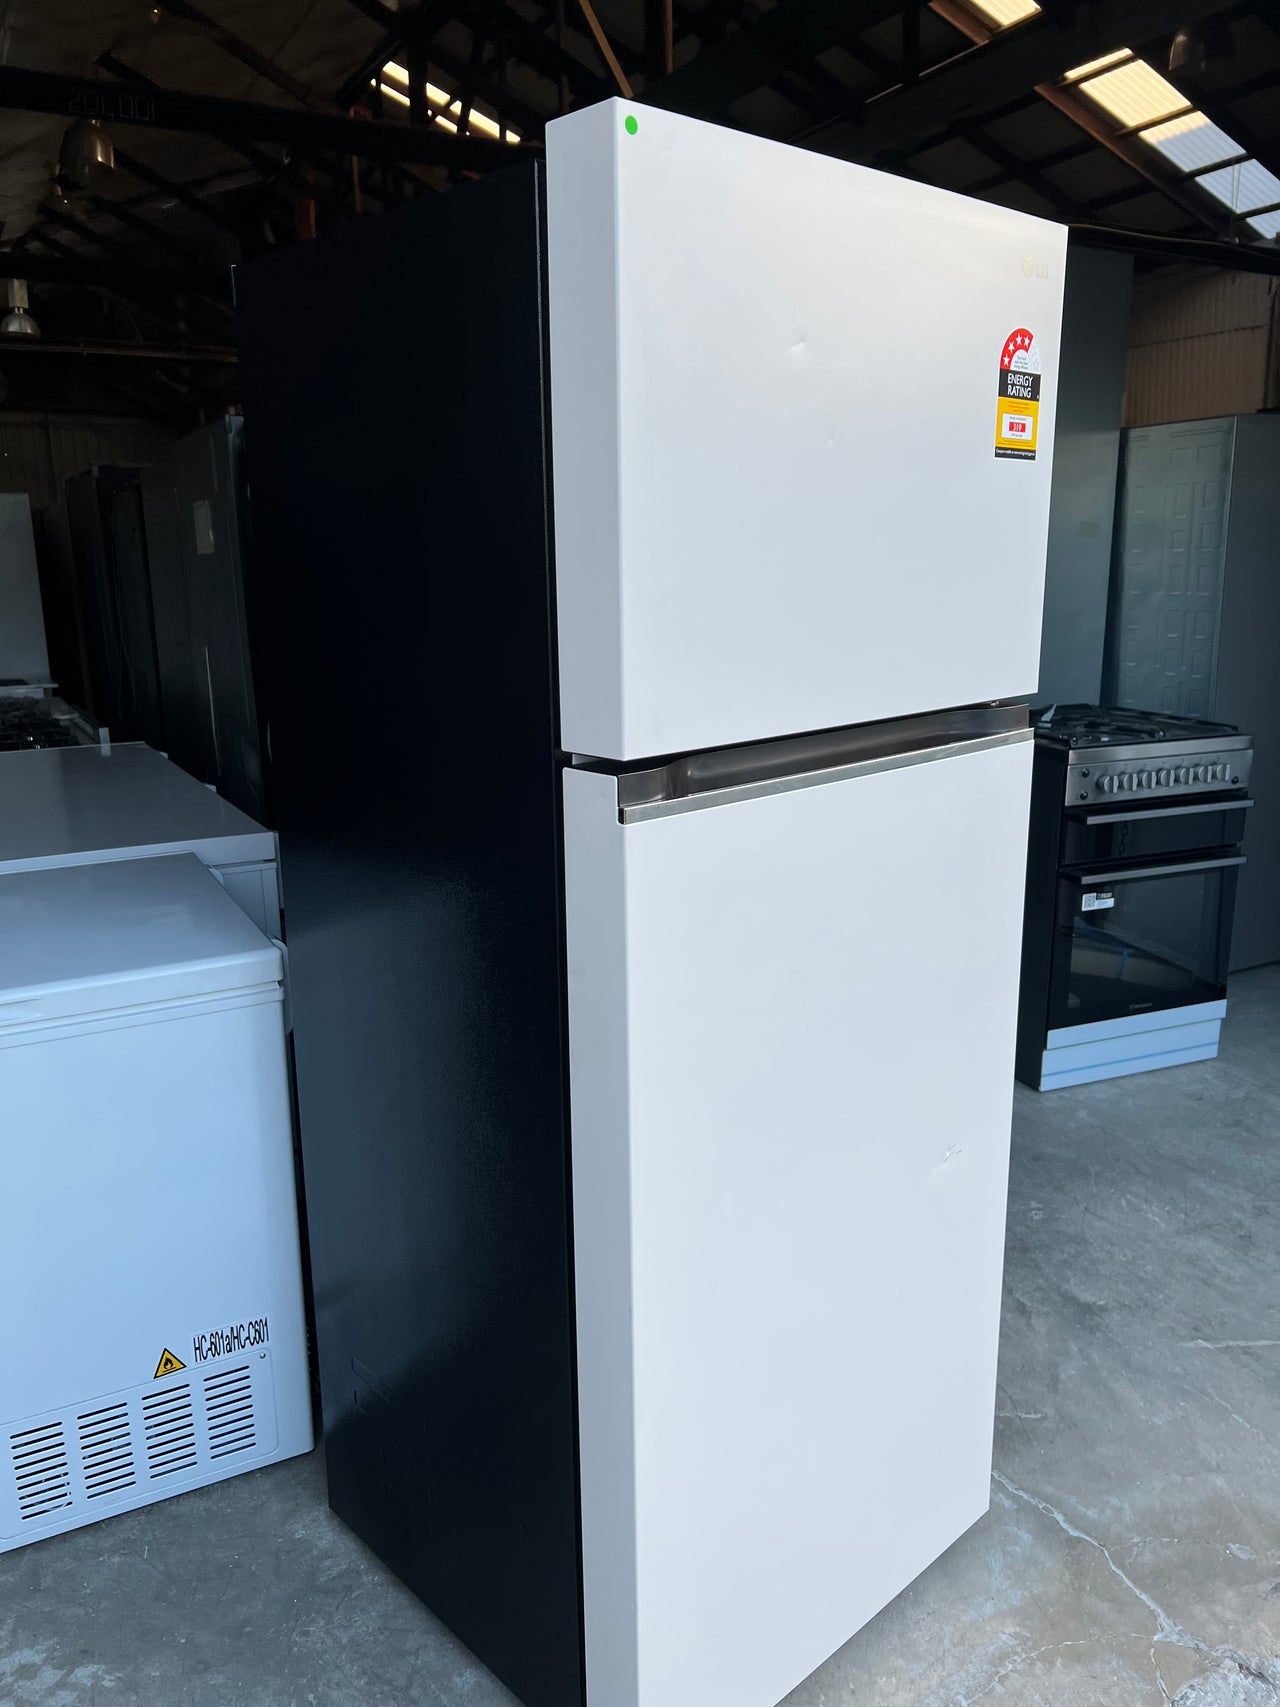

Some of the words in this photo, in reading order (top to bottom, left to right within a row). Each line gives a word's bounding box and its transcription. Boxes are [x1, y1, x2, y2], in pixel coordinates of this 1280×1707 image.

[1008, 373, 1033, 386] ENERGY
[1008, 385, 1032, 398] RATING
[193, 1317, 269, 1362] HC-601a/HC-C601
